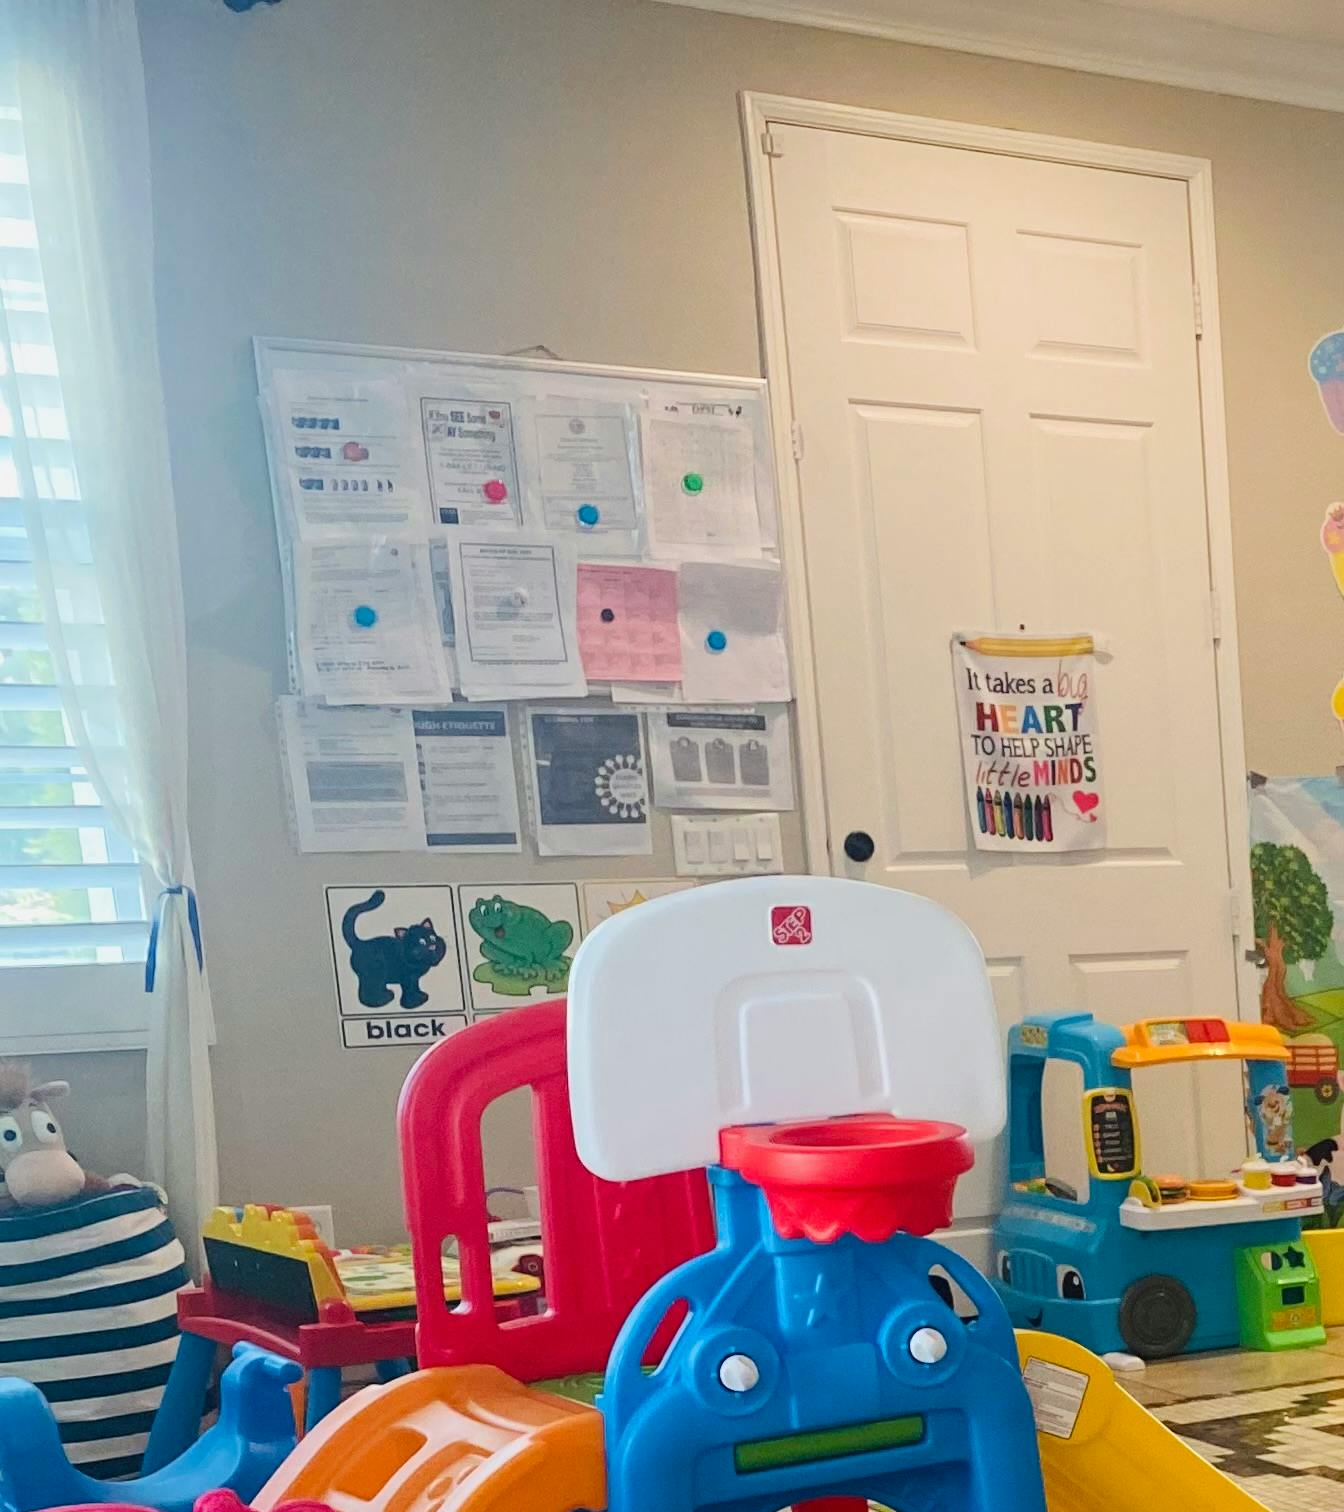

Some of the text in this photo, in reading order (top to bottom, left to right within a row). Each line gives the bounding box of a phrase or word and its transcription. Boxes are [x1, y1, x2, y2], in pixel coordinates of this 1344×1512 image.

[966, 668, 981, 691] It
[985, 671, 1036, 694] takes
[1042, 678, 1054, 694] a
[976, 702, 1084, 734] HEART
[971, 734, 1092, 758] TO HELP SHAPE
[975, 757, 1096, 787] little MINDS
[366, 1018, 446, 1042] black
